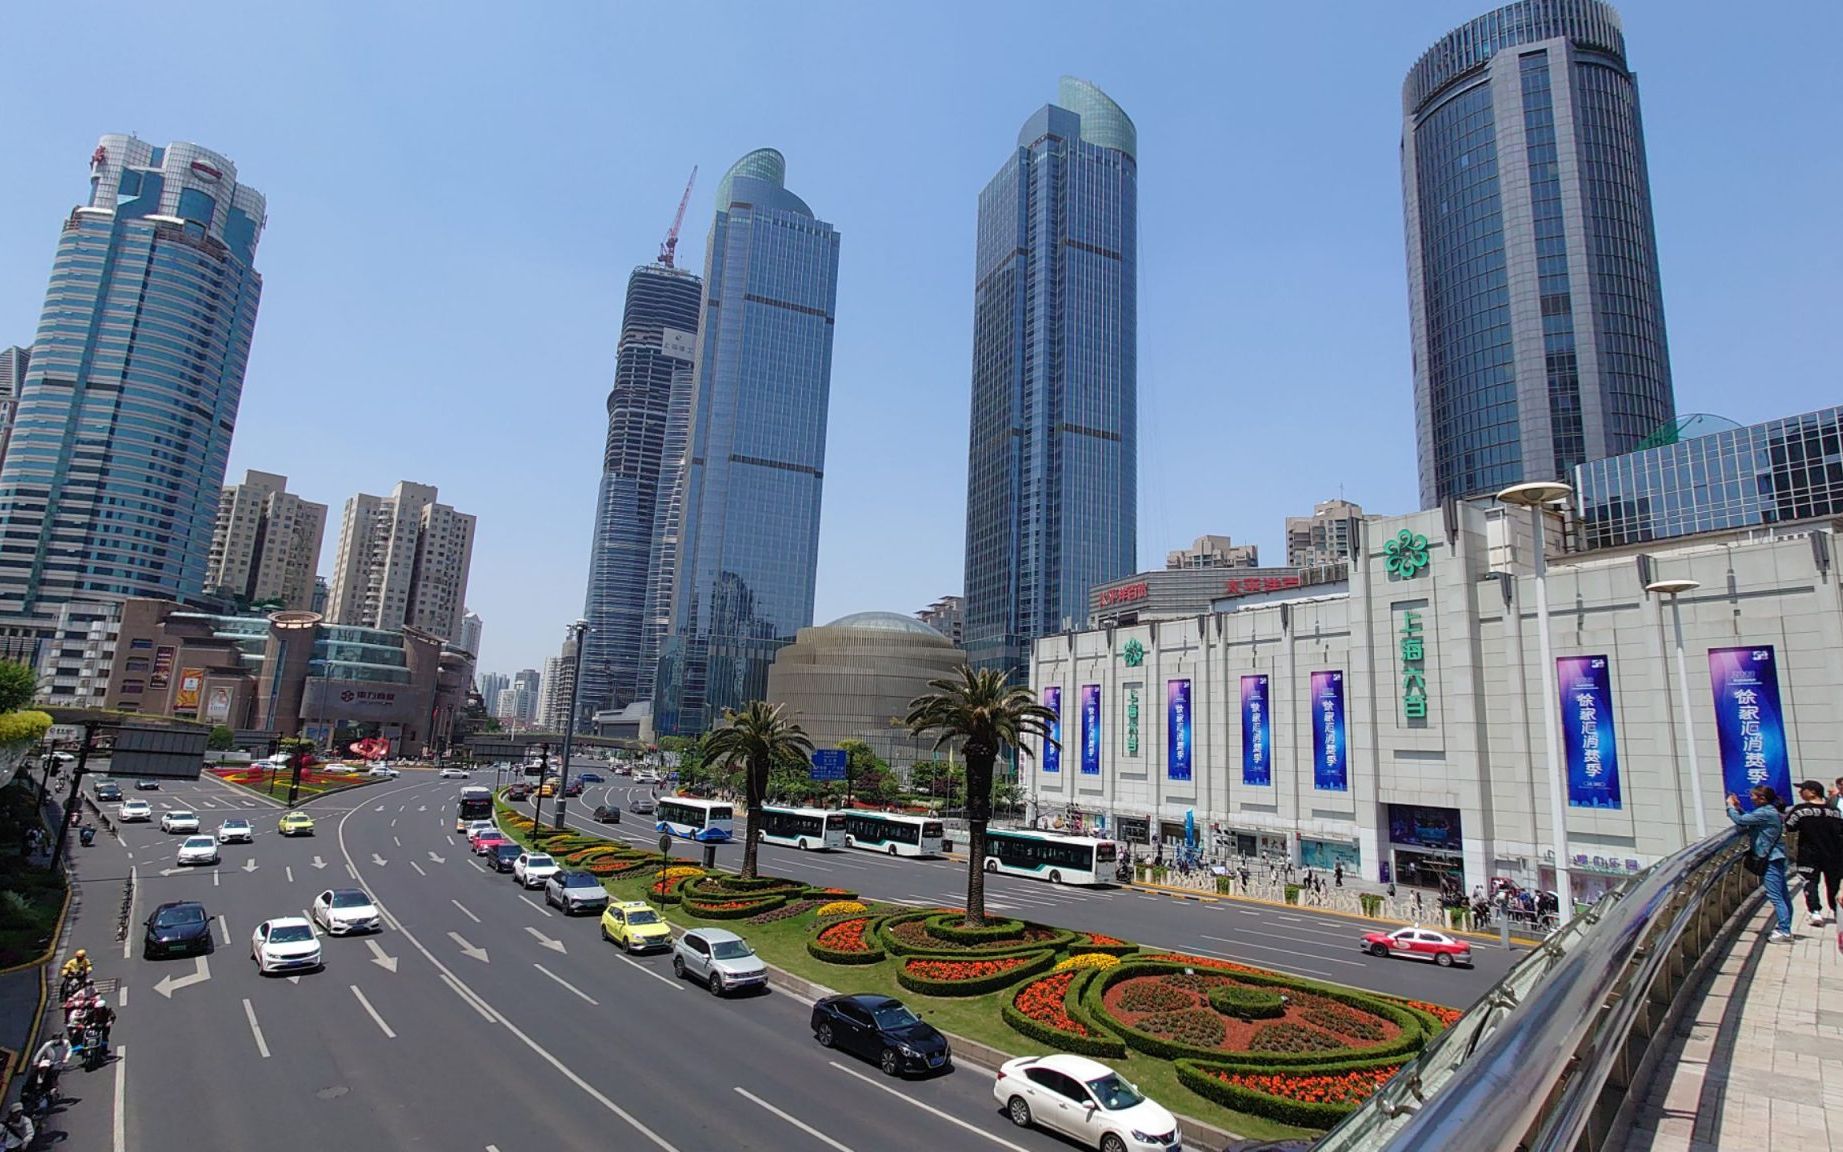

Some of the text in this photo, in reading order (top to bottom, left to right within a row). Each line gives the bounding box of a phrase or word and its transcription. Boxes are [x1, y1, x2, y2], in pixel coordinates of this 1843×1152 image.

[1100, 582, 1147, 608] 太平洋百货
[1400, 610, 1426, 718] 上海六百
[1127, 688, 1139, 752] 上海六百
[1322, 700, 1337, 766] 徐家汇消费季
[1576, 693, 1603, 777] 徐家汇消费季
[1734, 688, 1770, 784] 徐家汇消费季
